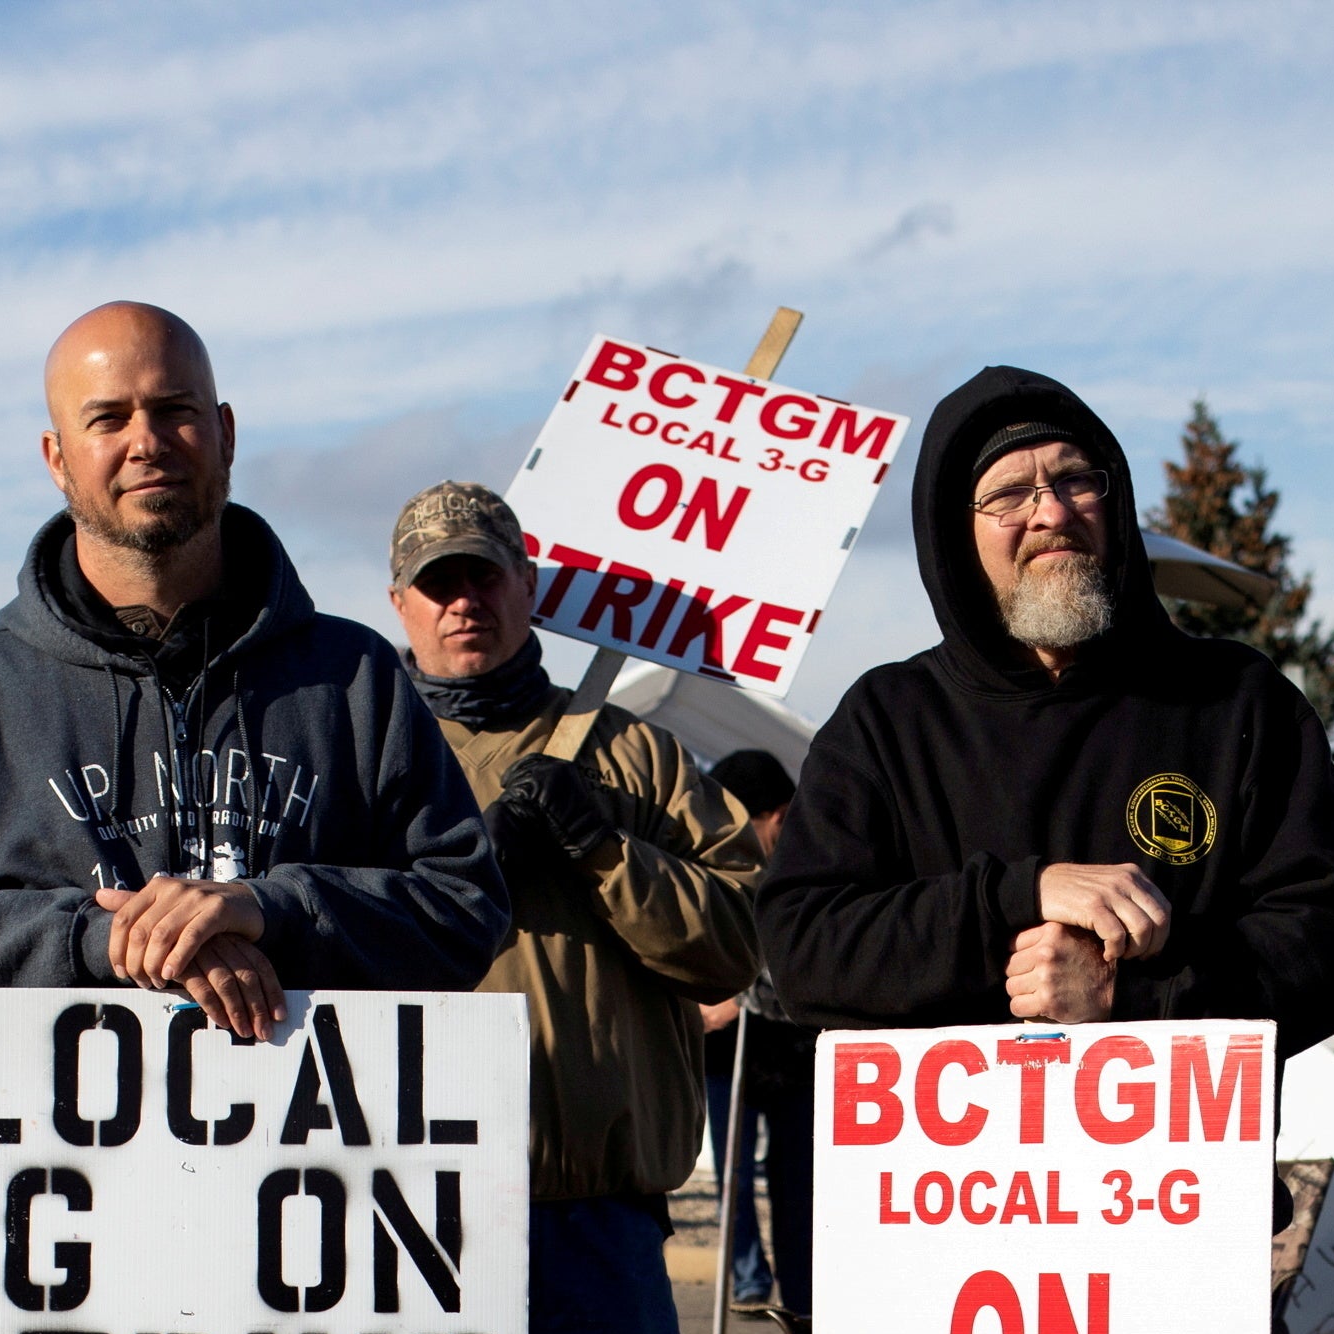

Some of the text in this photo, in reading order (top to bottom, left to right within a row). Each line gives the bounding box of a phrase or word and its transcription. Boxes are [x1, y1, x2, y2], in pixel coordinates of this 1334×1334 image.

[585, 340, 896, 460] BCTGM
[600, 402, 832, 483] LOCAL 3-G
[413, 492, 481, 525] BCTGM
[617, 463, 752, 553] ON
[522, 531, 806, 683] TRIKE
[48, 748, 319, 827] UP NORTH
[207, 809, 281, 838] RADITON
[1155, 799, 1190, 833] BCTGM
[831, 1033, 1264, 1147] BCTGM
[878, 1168, 1201, 1225] LOCAL 3-G
[256, 1167, 462, 1314] ON
